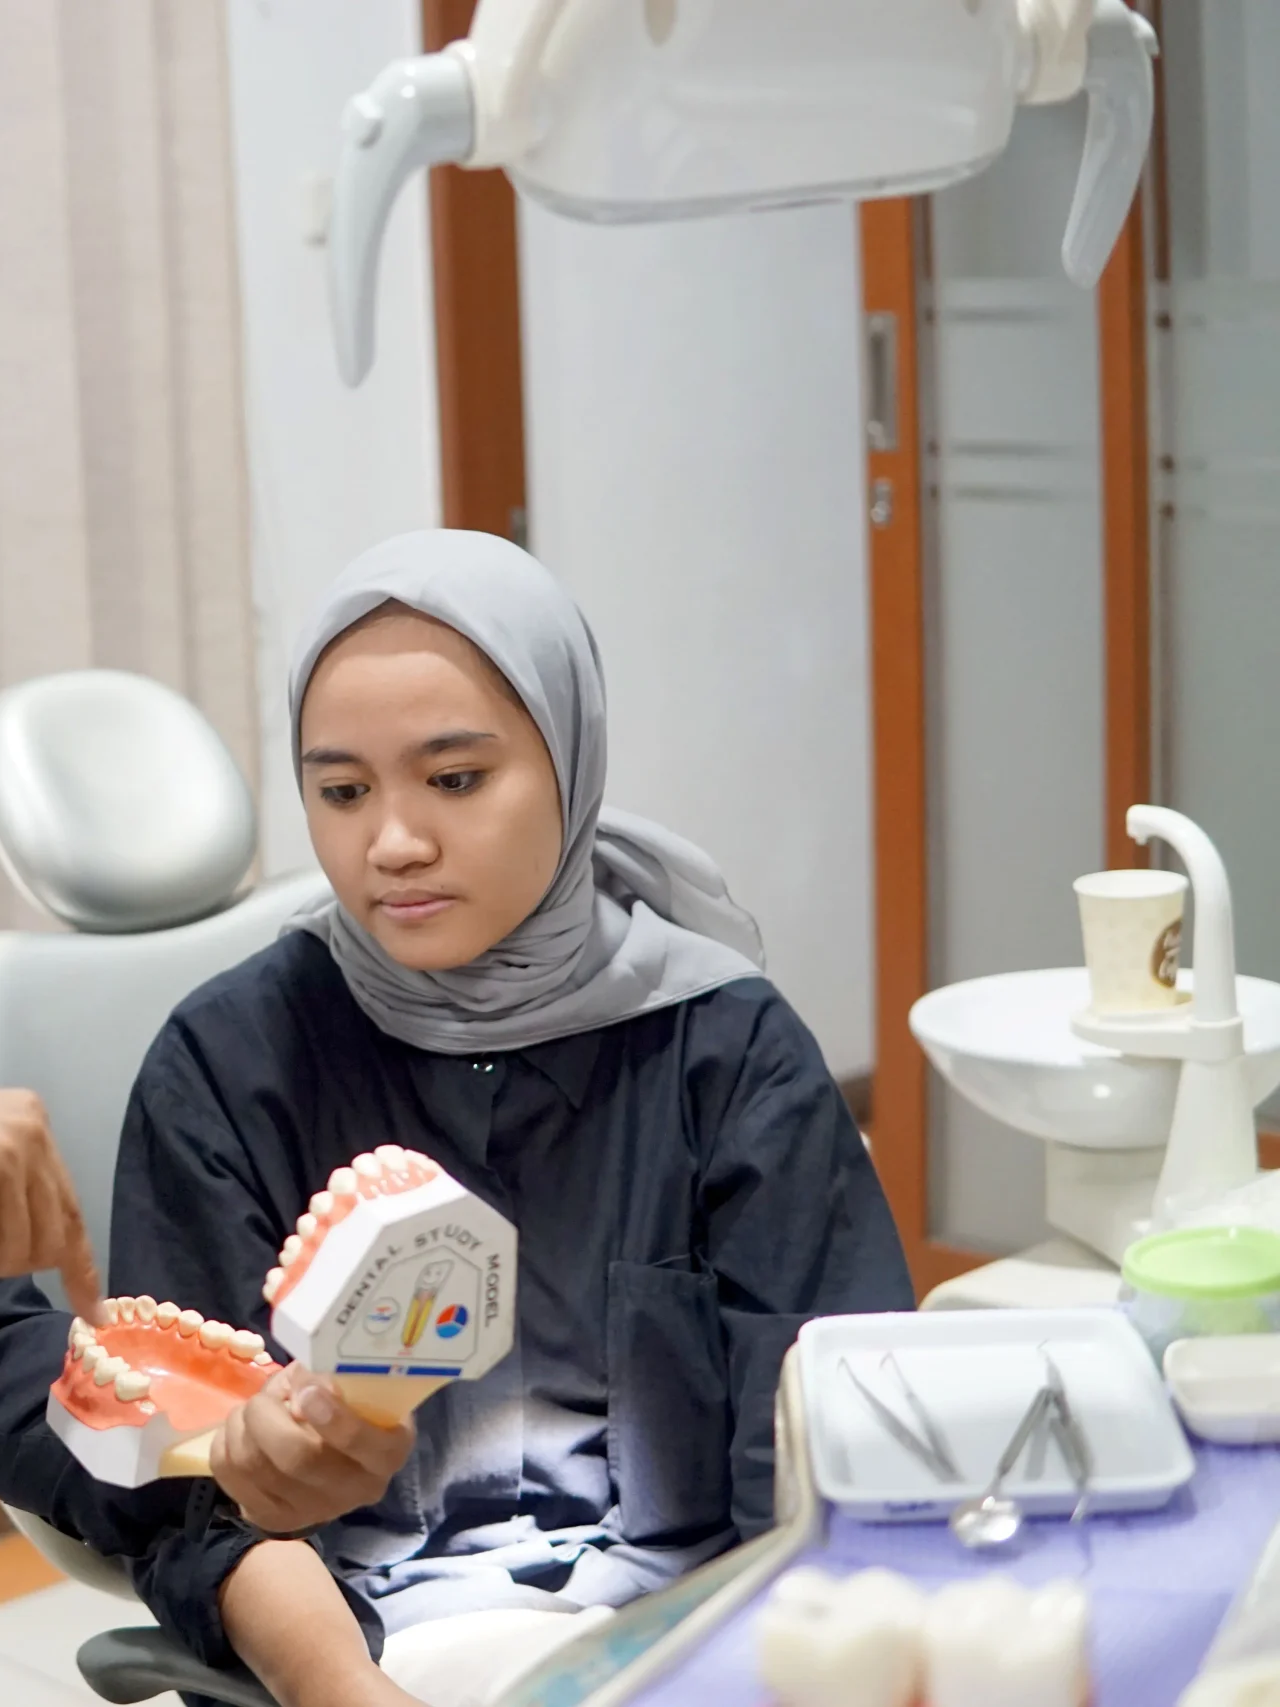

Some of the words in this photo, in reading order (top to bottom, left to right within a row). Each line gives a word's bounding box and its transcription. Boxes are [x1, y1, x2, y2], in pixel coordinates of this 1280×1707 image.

[336, 1245, 402, 1327] DENTAL
[414, 1224, 483, 1251] STUDY
[484, 1253, 500, 1328] MODEL
